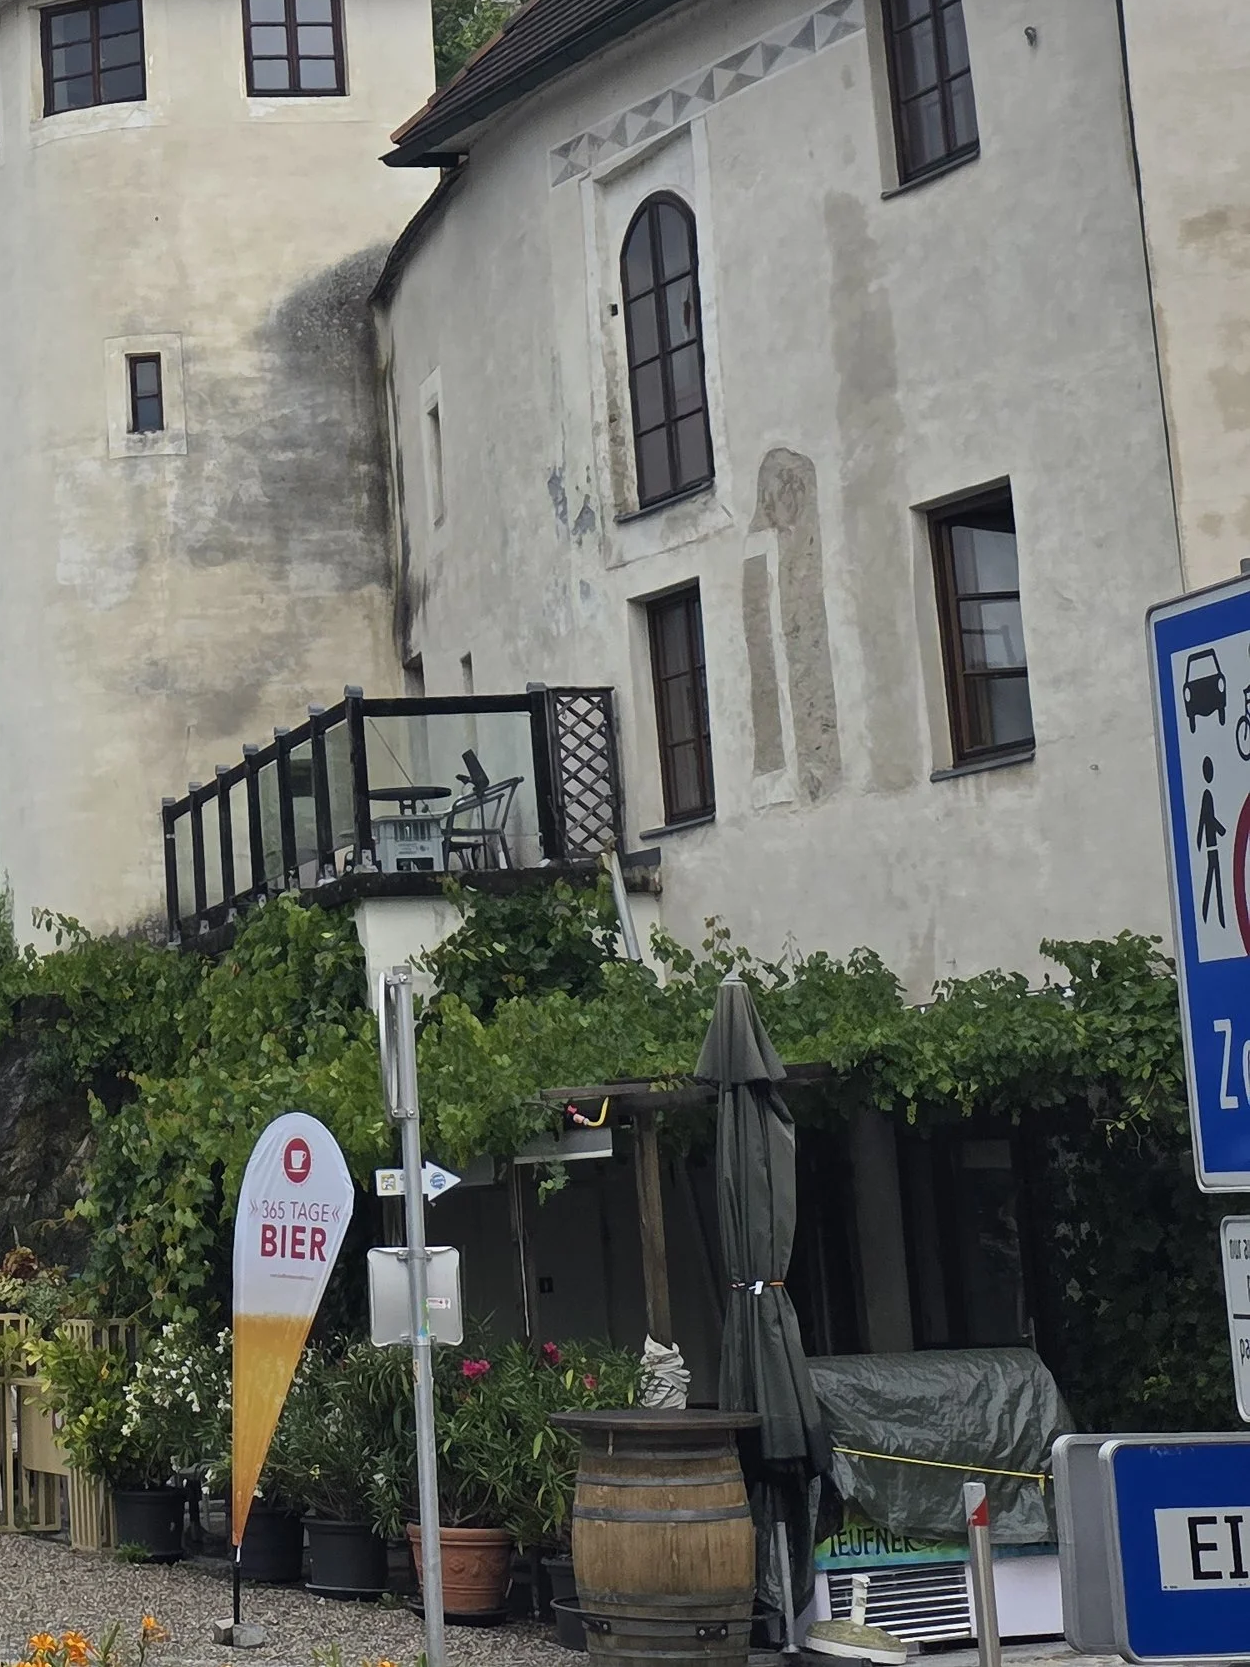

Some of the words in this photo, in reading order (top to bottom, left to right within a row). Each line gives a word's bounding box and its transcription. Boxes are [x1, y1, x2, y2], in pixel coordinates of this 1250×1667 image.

[1213, 1018, 1250, 1109] Z
[261, 1224, 327, 1262] BIER
[1187, 1515, 1249, 1581] EI
